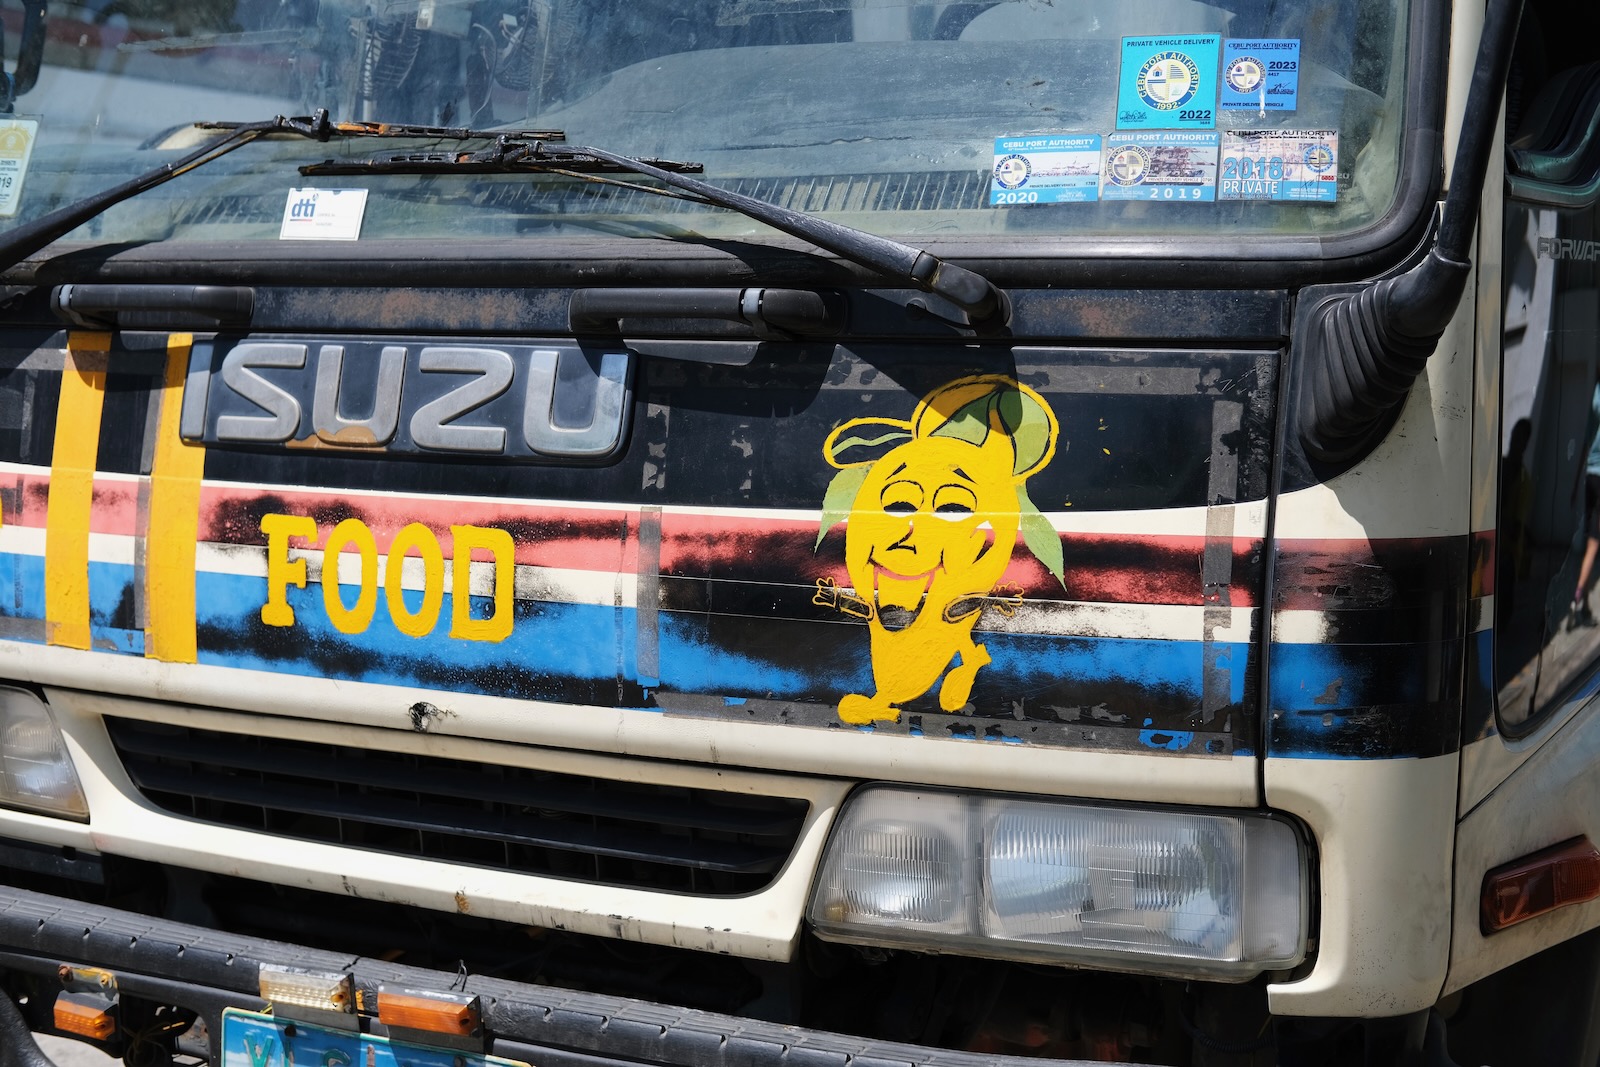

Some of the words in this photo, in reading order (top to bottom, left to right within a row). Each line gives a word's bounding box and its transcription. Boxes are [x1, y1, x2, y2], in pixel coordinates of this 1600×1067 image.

[1269, 61, 1297, 70] 2023
[1137, 70, 1148, 98] CEBU
[1144, 52, 1168, 71] PORT
[1169, 52, 1199, 97] AUTHORITY
[1156, 101, 1179, 110] 1992
[1180, 110, 1211, 119] 2022
[1049, 138, 1094, 146] AUTHORITY
[1222, 157, 1283, 180] 2018
[1150, 188, 1202, 199] 2019
[1223, 181, 1278, 194] PRIVATE
[996, 192, 1038, 204] 2020
[291, 198, 316, 217] dti
[181, 340, 629, 457] ISUZU
[260, 512, 515, 643] FOOD
